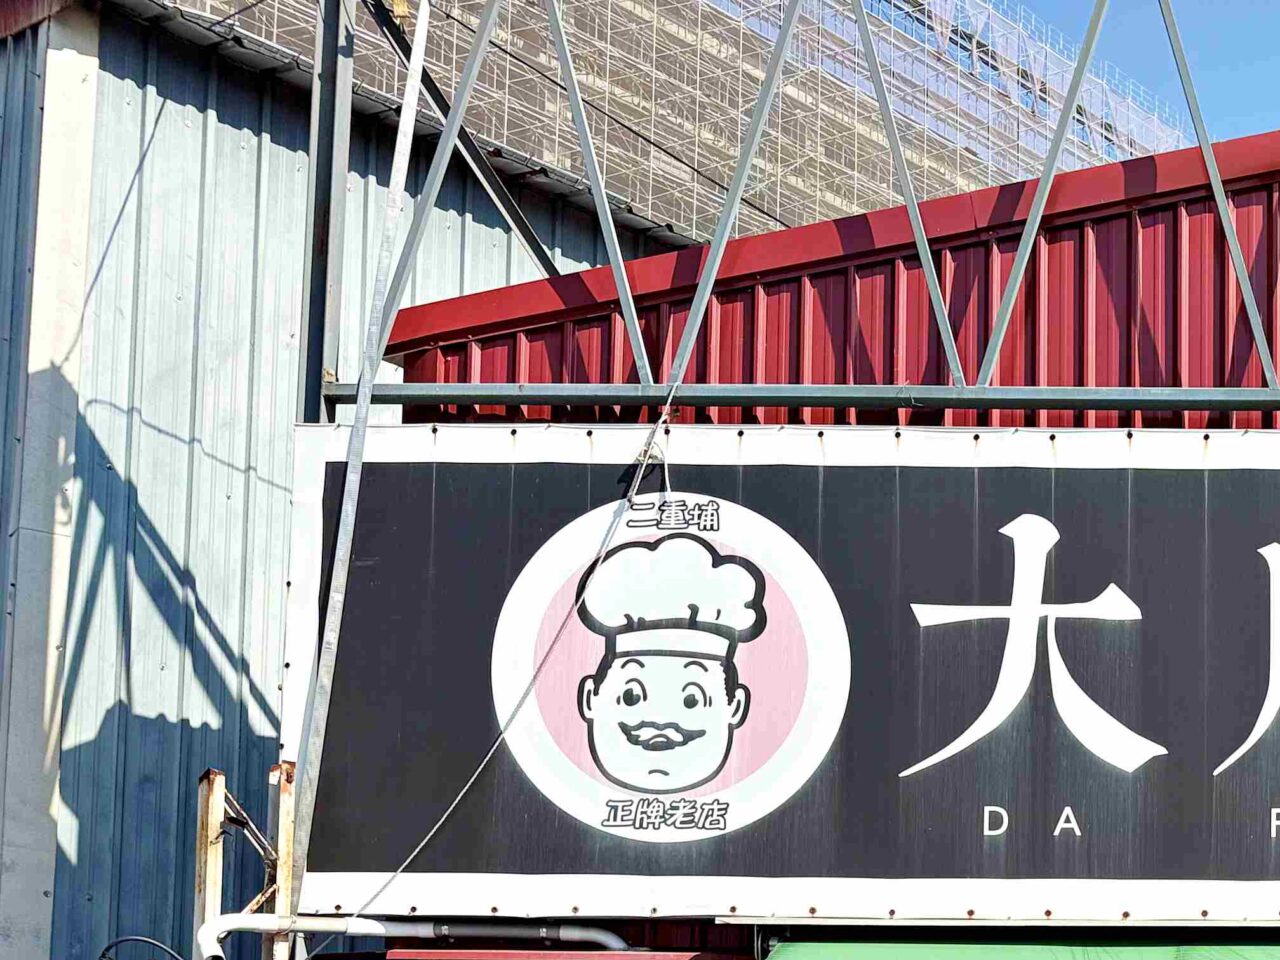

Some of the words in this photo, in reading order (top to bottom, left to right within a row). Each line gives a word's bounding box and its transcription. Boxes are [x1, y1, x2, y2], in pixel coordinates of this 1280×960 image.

[626, 500, 720, 531] 二重埔
[601, 798, 729, 830] 正牌老店
[983, 805, 1083, 837] DA
